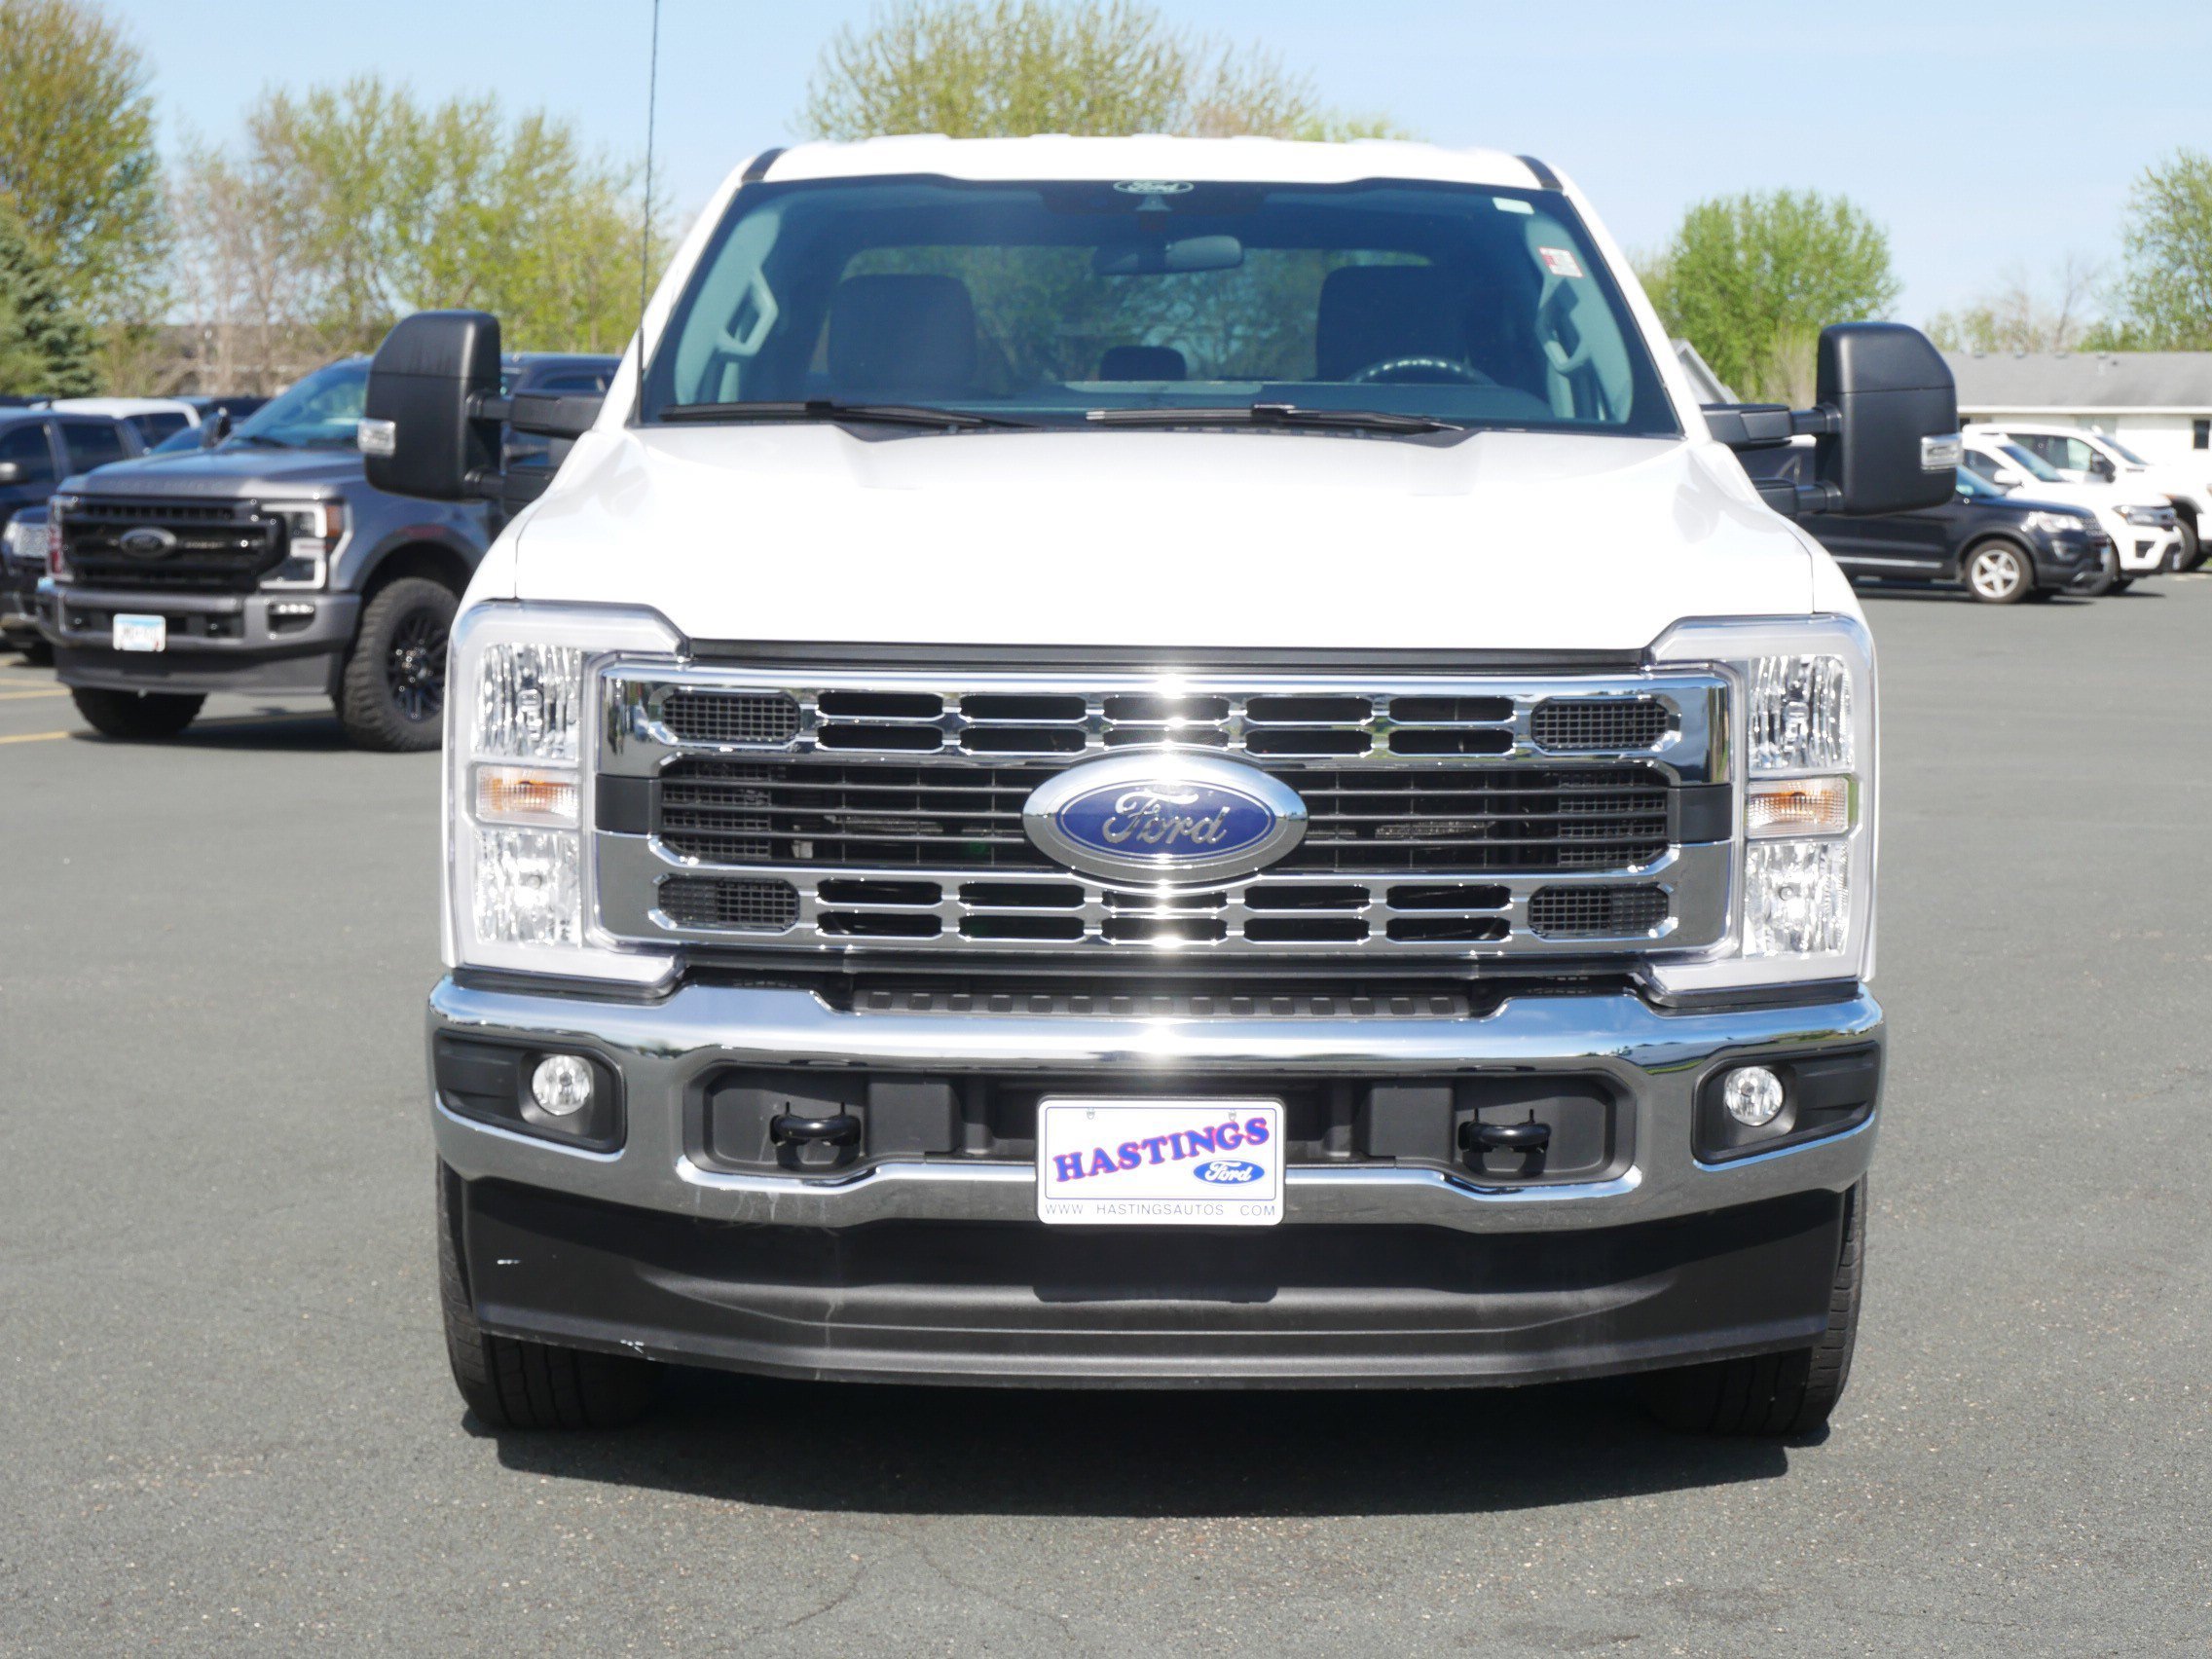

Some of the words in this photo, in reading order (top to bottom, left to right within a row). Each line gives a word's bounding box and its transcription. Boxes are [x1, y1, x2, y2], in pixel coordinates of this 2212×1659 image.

[1103, 790, 1231, 844] Ford
[1053, 1117, 1270, 1182] HASTINGS
[1204, 1161, 1253, 1182] Ford
